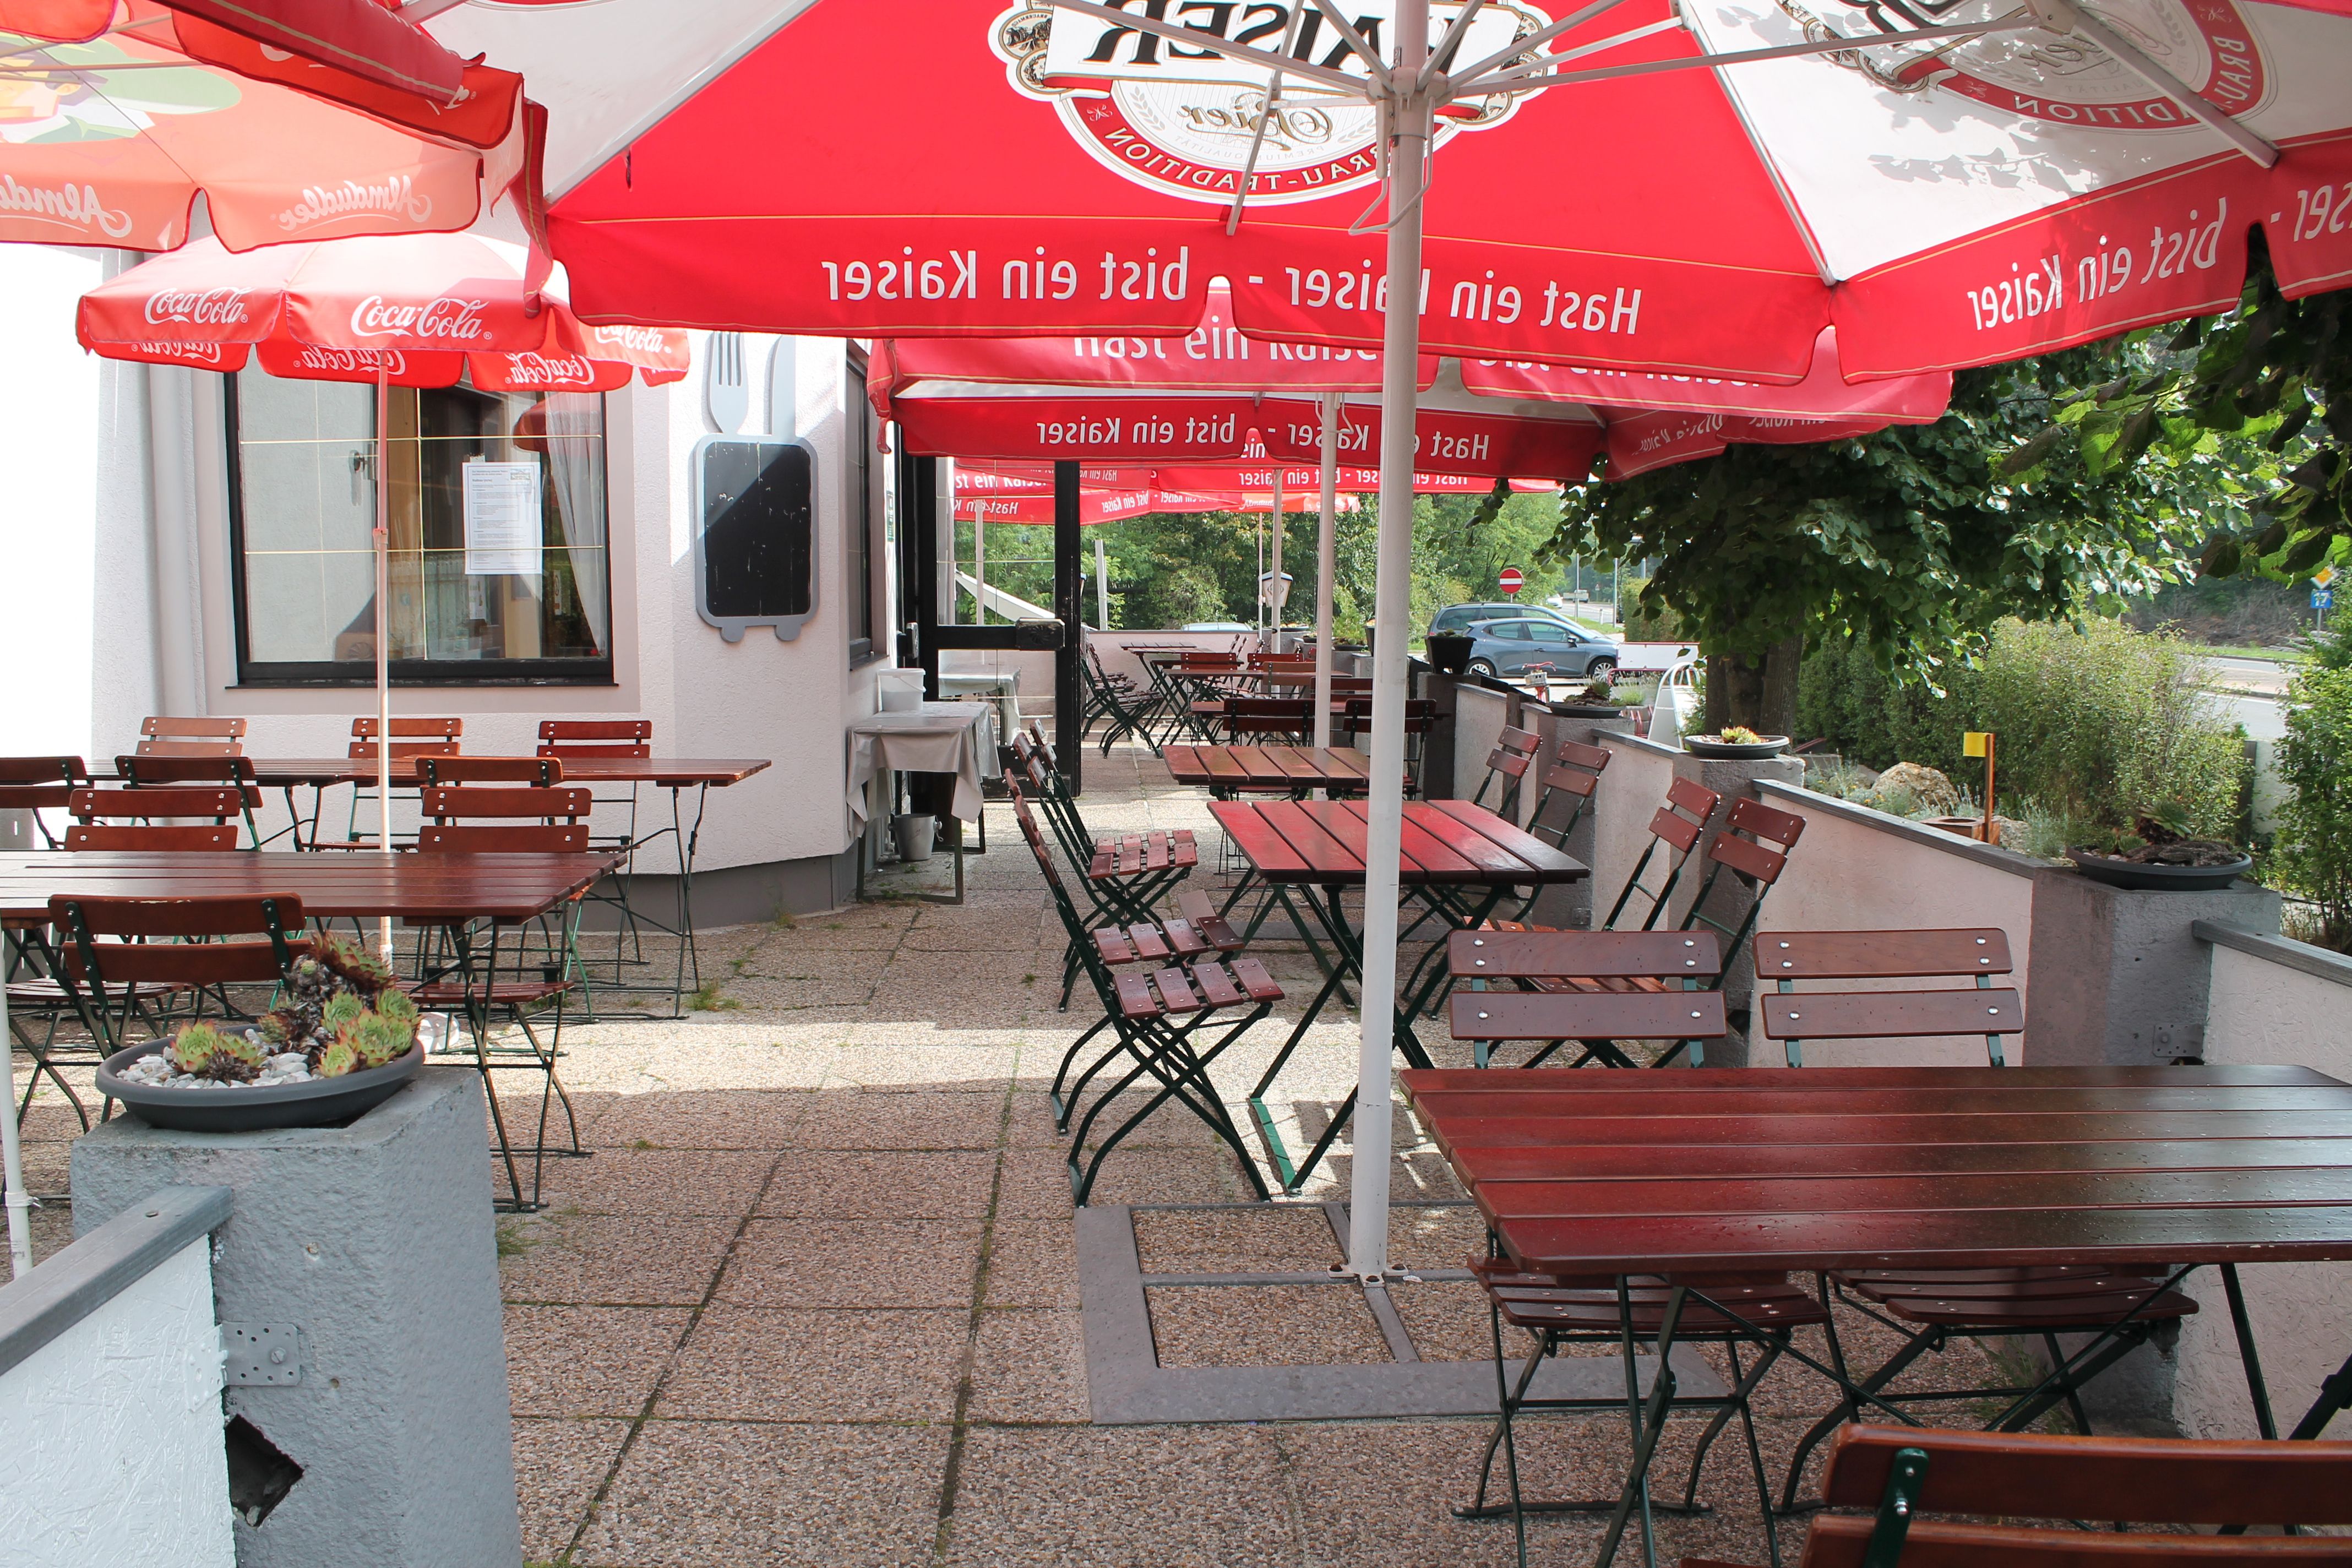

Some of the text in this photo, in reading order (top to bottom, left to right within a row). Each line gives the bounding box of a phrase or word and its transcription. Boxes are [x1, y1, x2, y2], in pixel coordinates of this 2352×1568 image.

[145, 286, 255, 325] Coca-Cola
[351, 295, 489, 339] Coca-Cola
[595, 325, 663, 353] ocaCola
